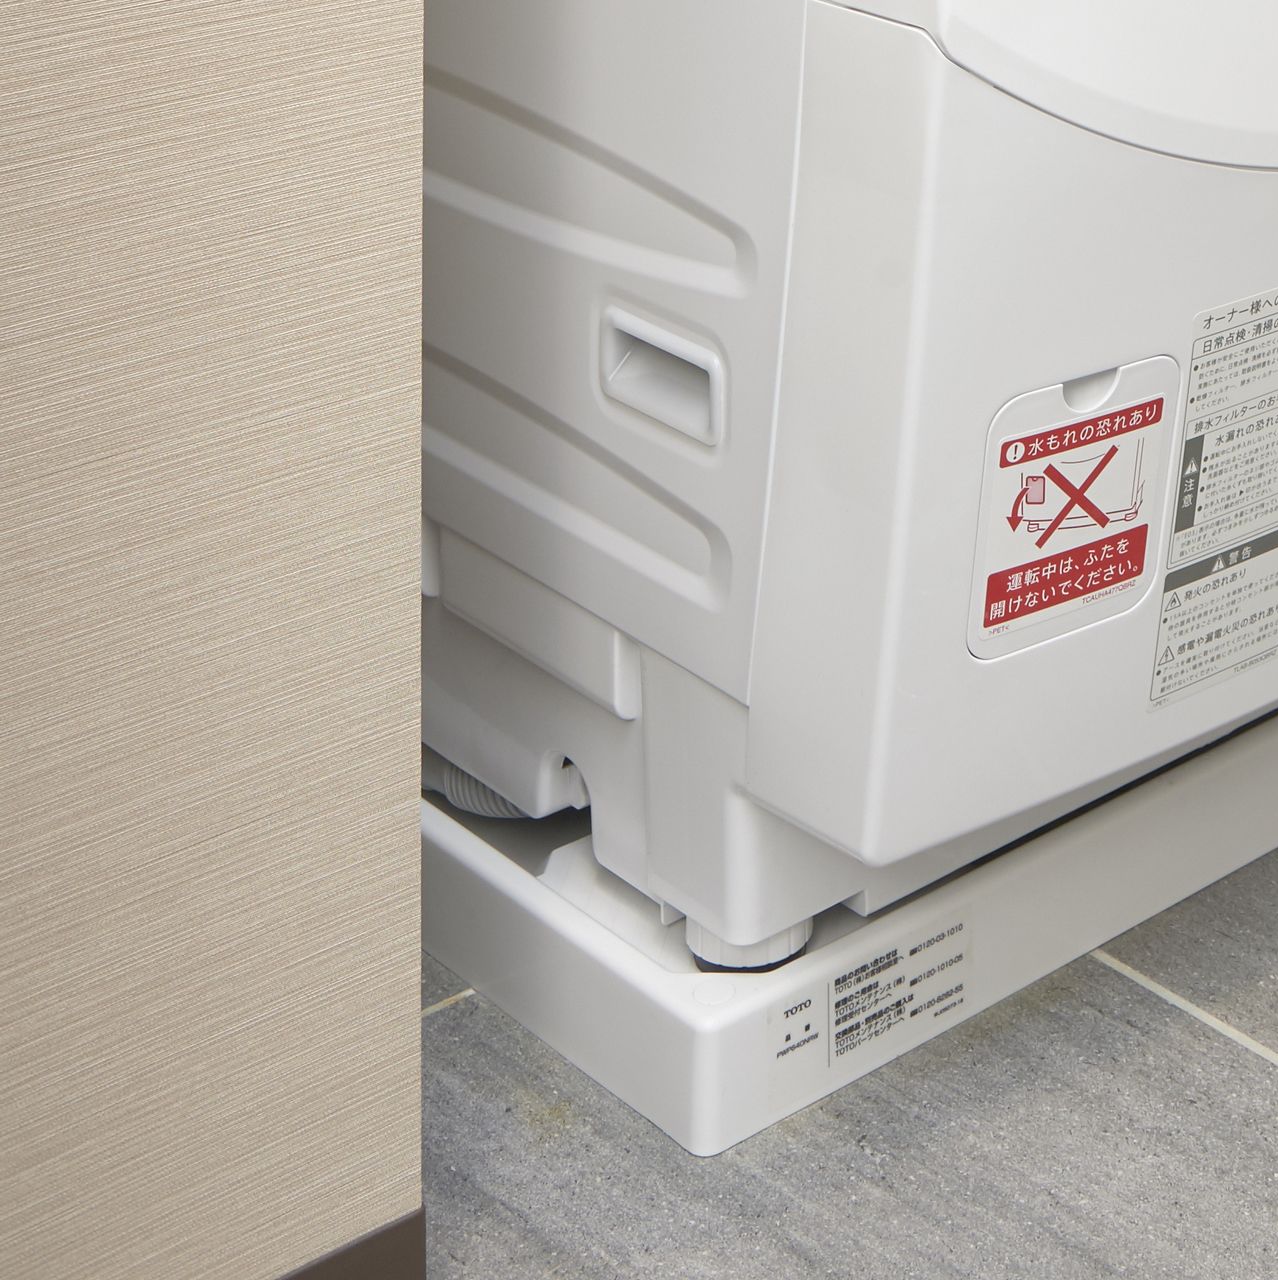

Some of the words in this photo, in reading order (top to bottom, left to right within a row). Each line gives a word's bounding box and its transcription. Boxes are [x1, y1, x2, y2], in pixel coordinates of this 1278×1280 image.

[1029, 404, 1157, 456] 水もれの恐れあり
[1181, 476, 1195, 509] 注意
[1006, 538, 1130, 592] 運転中は、ふたを
[1227, 544, 1252, 566] 警告
[990, 562, 1138, 620] 開けないでください。
[1183, 567, 1246, 602] 発火の恐れあり
[784, 999, 811, 1018] TOTO
